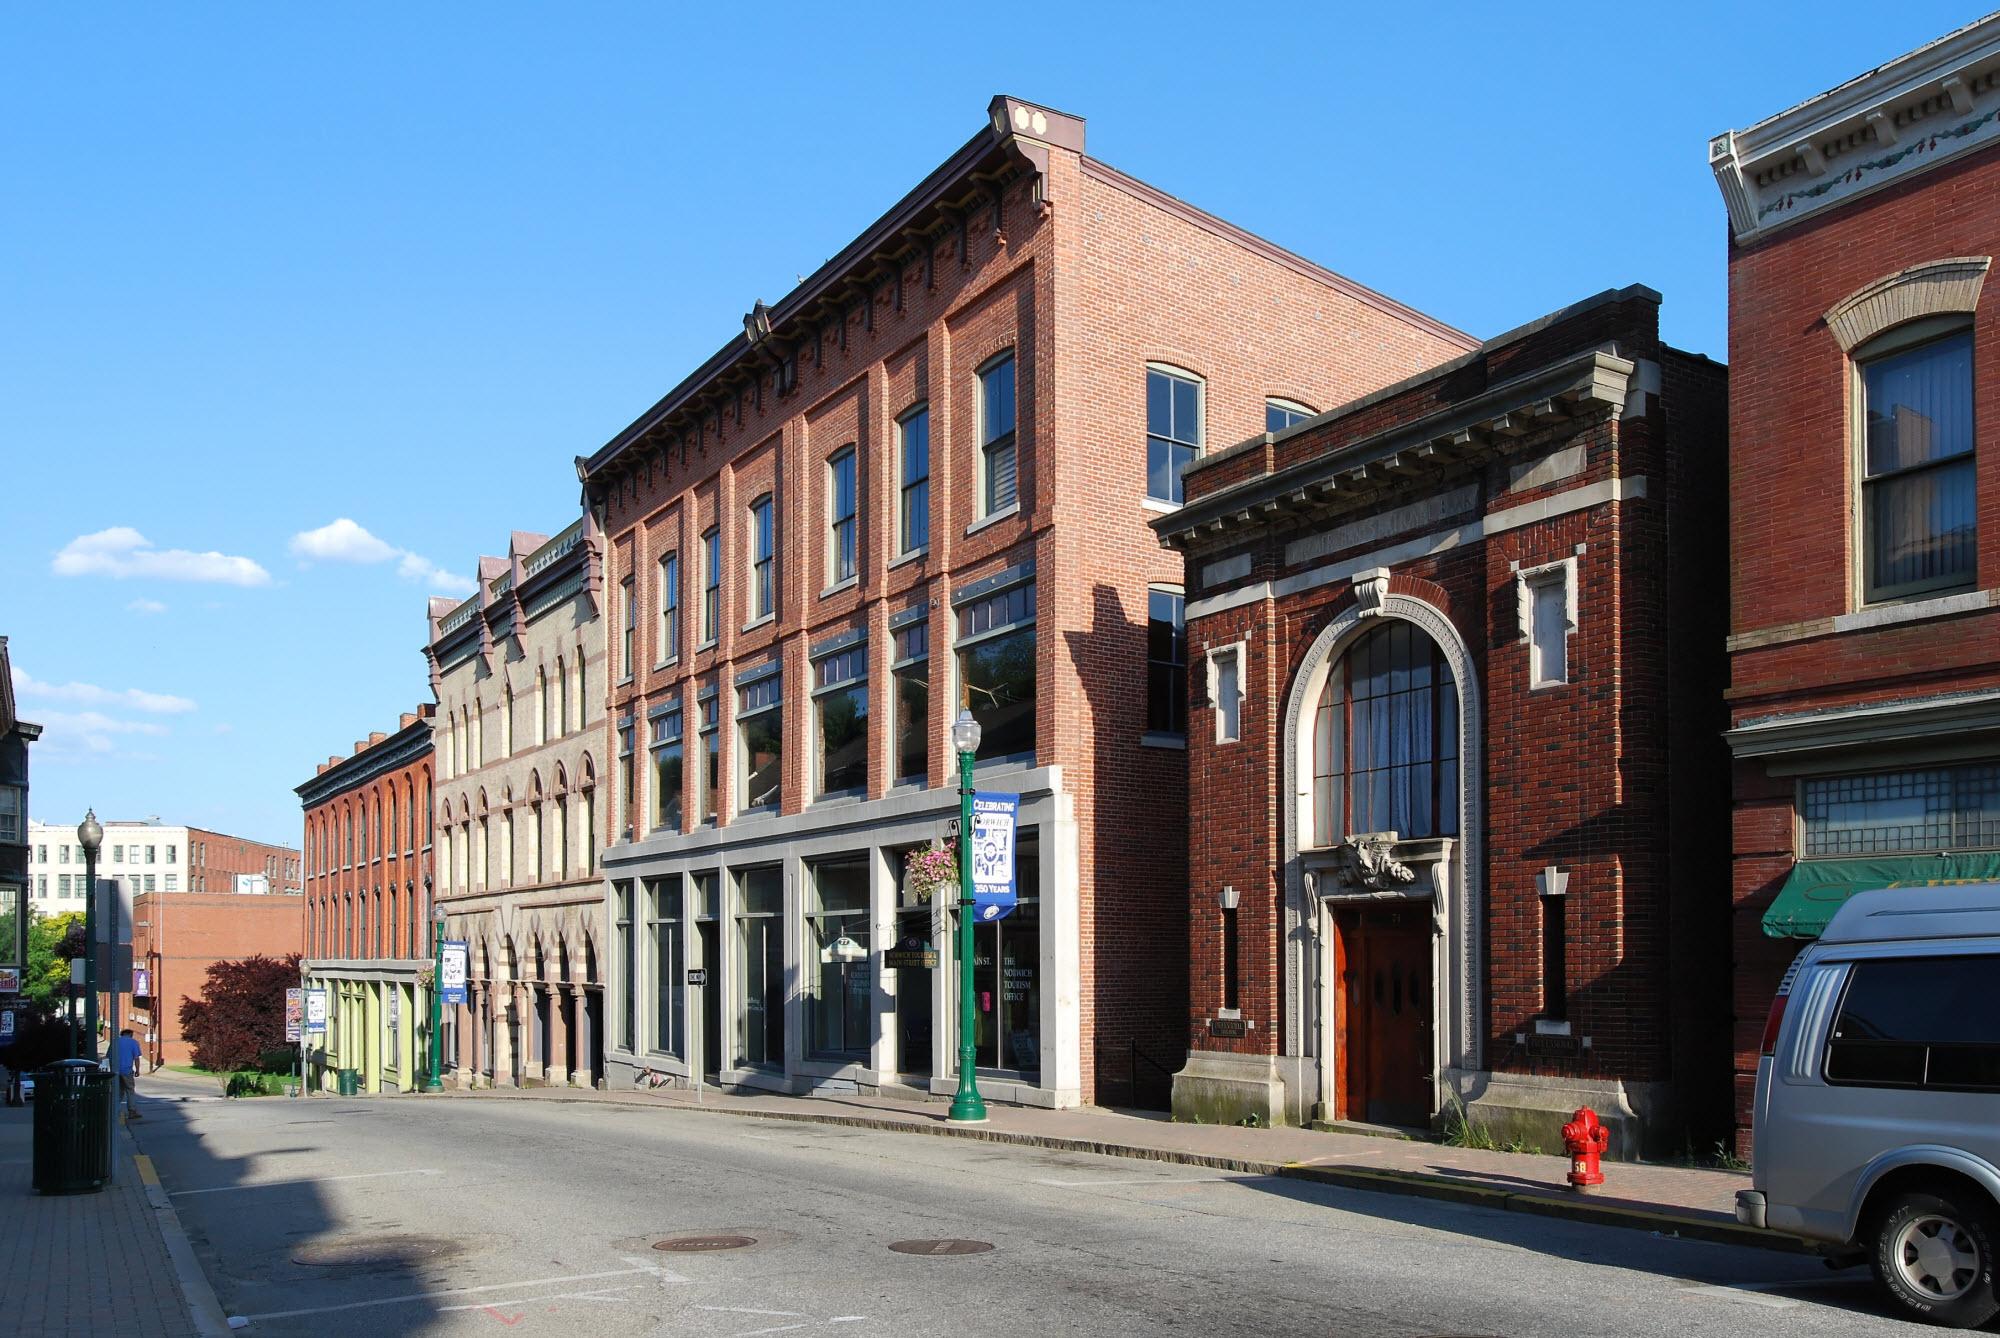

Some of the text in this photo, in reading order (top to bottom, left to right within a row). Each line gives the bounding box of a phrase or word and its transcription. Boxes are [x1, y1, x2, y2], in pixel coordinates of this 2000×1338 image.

[974, 799, 1015, 812] CELEBRATING
[974, 884, 1010, 894] 350 YEARS
[1003, 957, 1016, 966] THE
[1003, 968, 1033, 978] NORWICH
[1003, 980, 1031, 990] TOURISM
[1003, 992, 1024, 1002] OFFICE
[1575, 1161, 1587, 1173] 58
